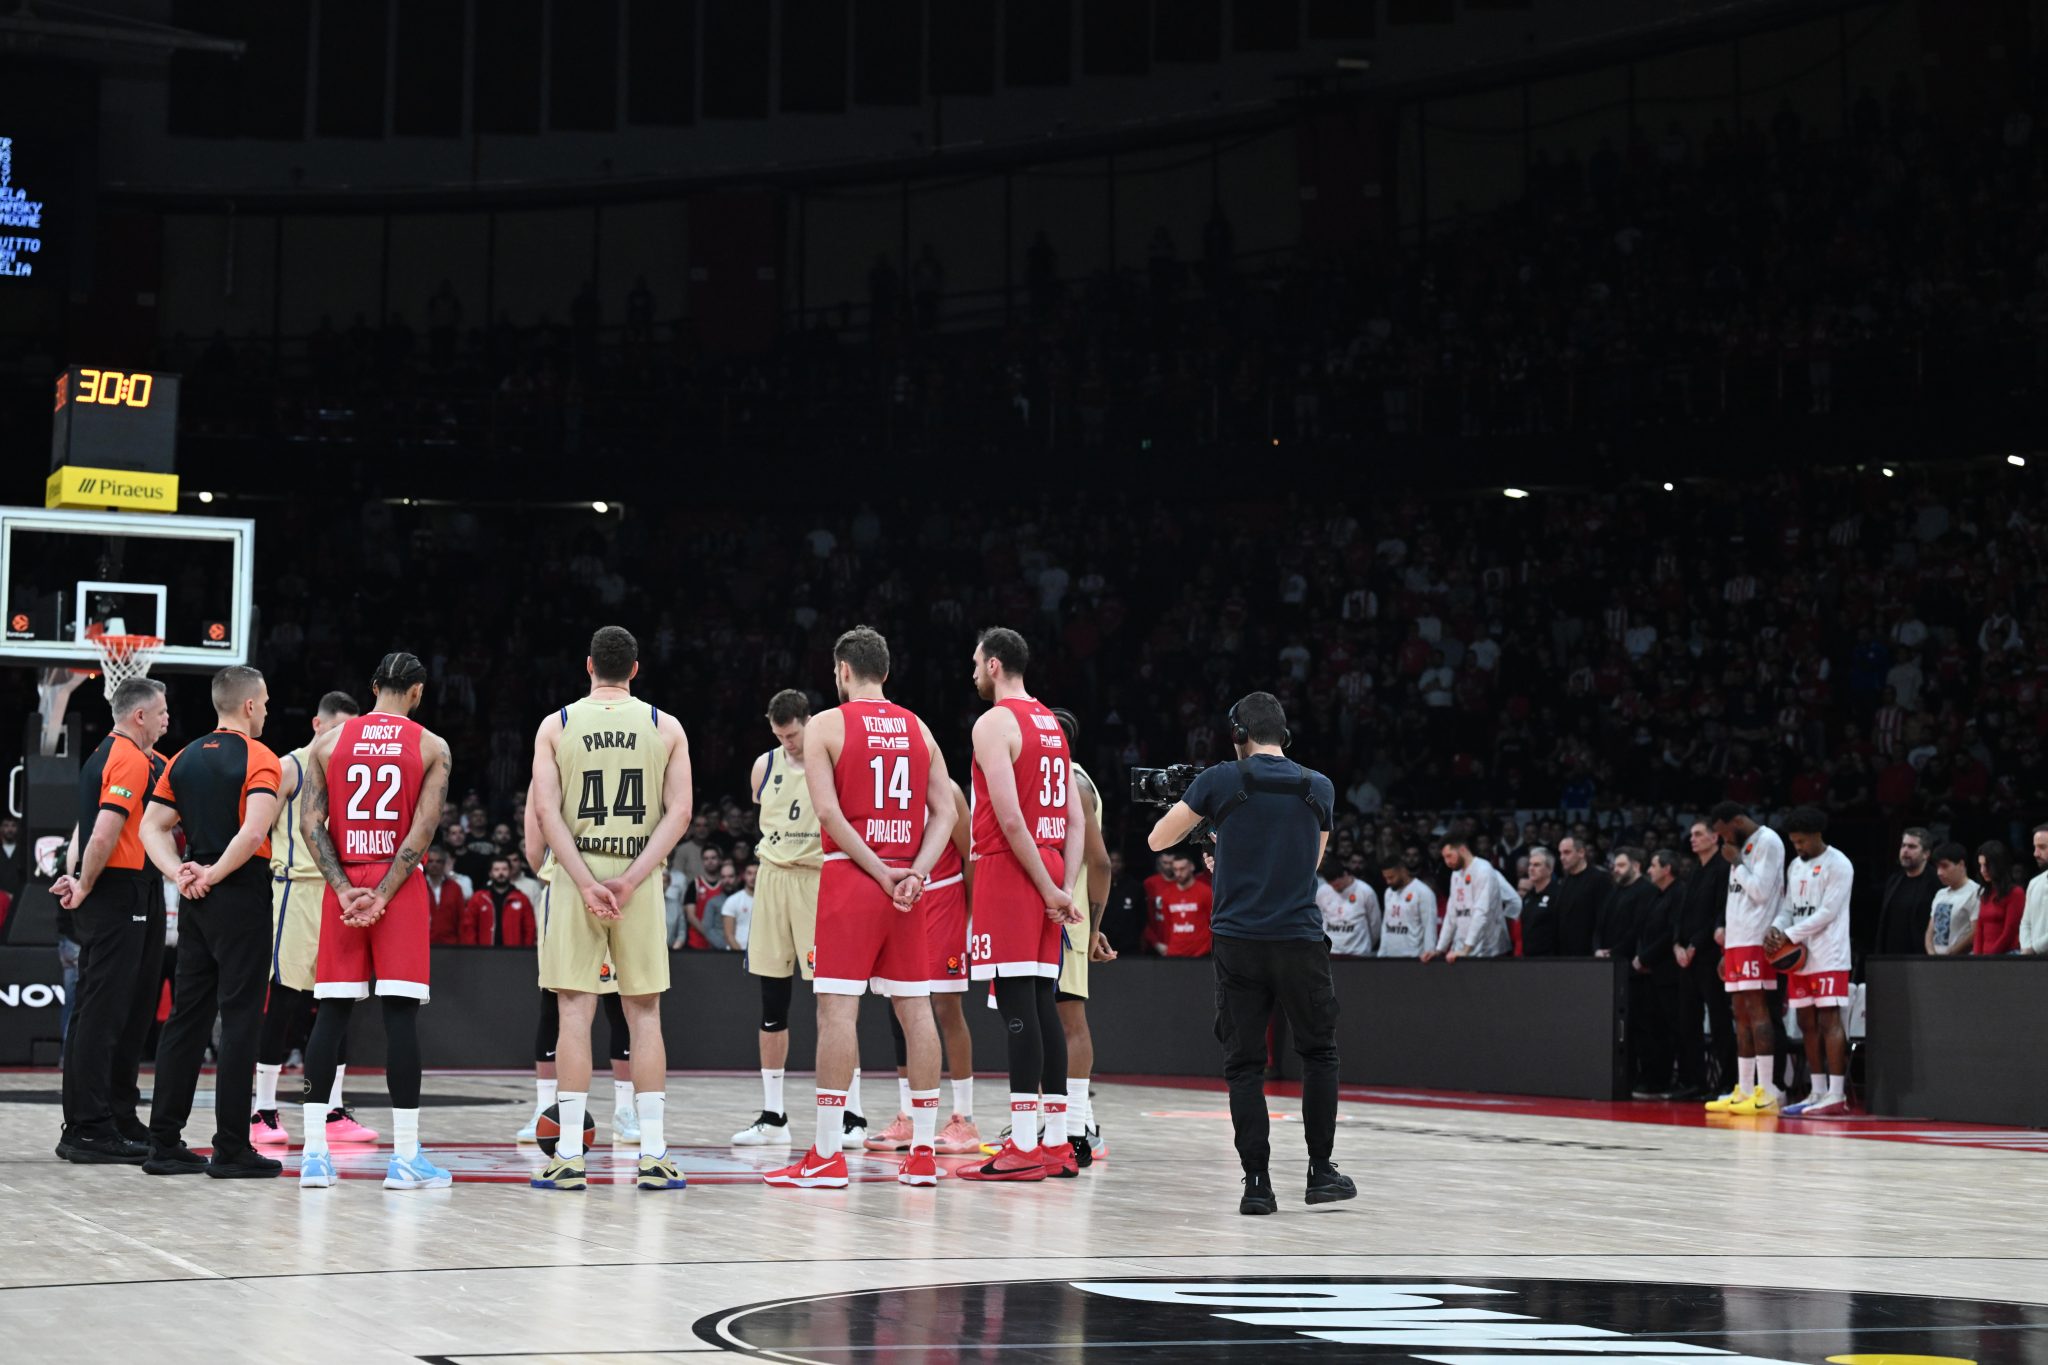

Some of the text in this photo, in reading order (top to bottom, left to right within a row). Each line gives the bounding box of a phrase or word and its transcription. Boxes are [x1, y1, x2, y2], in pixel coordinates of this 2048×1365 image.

[100, 479, 164, 499] Piraeus
[361, 725, 403, 740] DORSEY
[862, 715, 907, 733] VEZENKOV
[353, 743, 403, 756] FMS
[582, 731, 637, 752] PARRA
[867, 735, 910, 749] FMS
[347, 764, 401, 820] 22
[869, 755, 912, 810] 14
[1039, 756, 1066, 808] 33
[577, 768, 646, 826] 44
[788, 799, 801, 821] 6
[346, 829, 397, 855] PIRAEUS
[865, 819, 912, 844] PIRAEUS
[971, 933, 992, 960] 33
[1742, 960, 1760, 978] 45
[1818, 976, 1835, 995] 77
[818, 1096, 843, 1106] GSA
